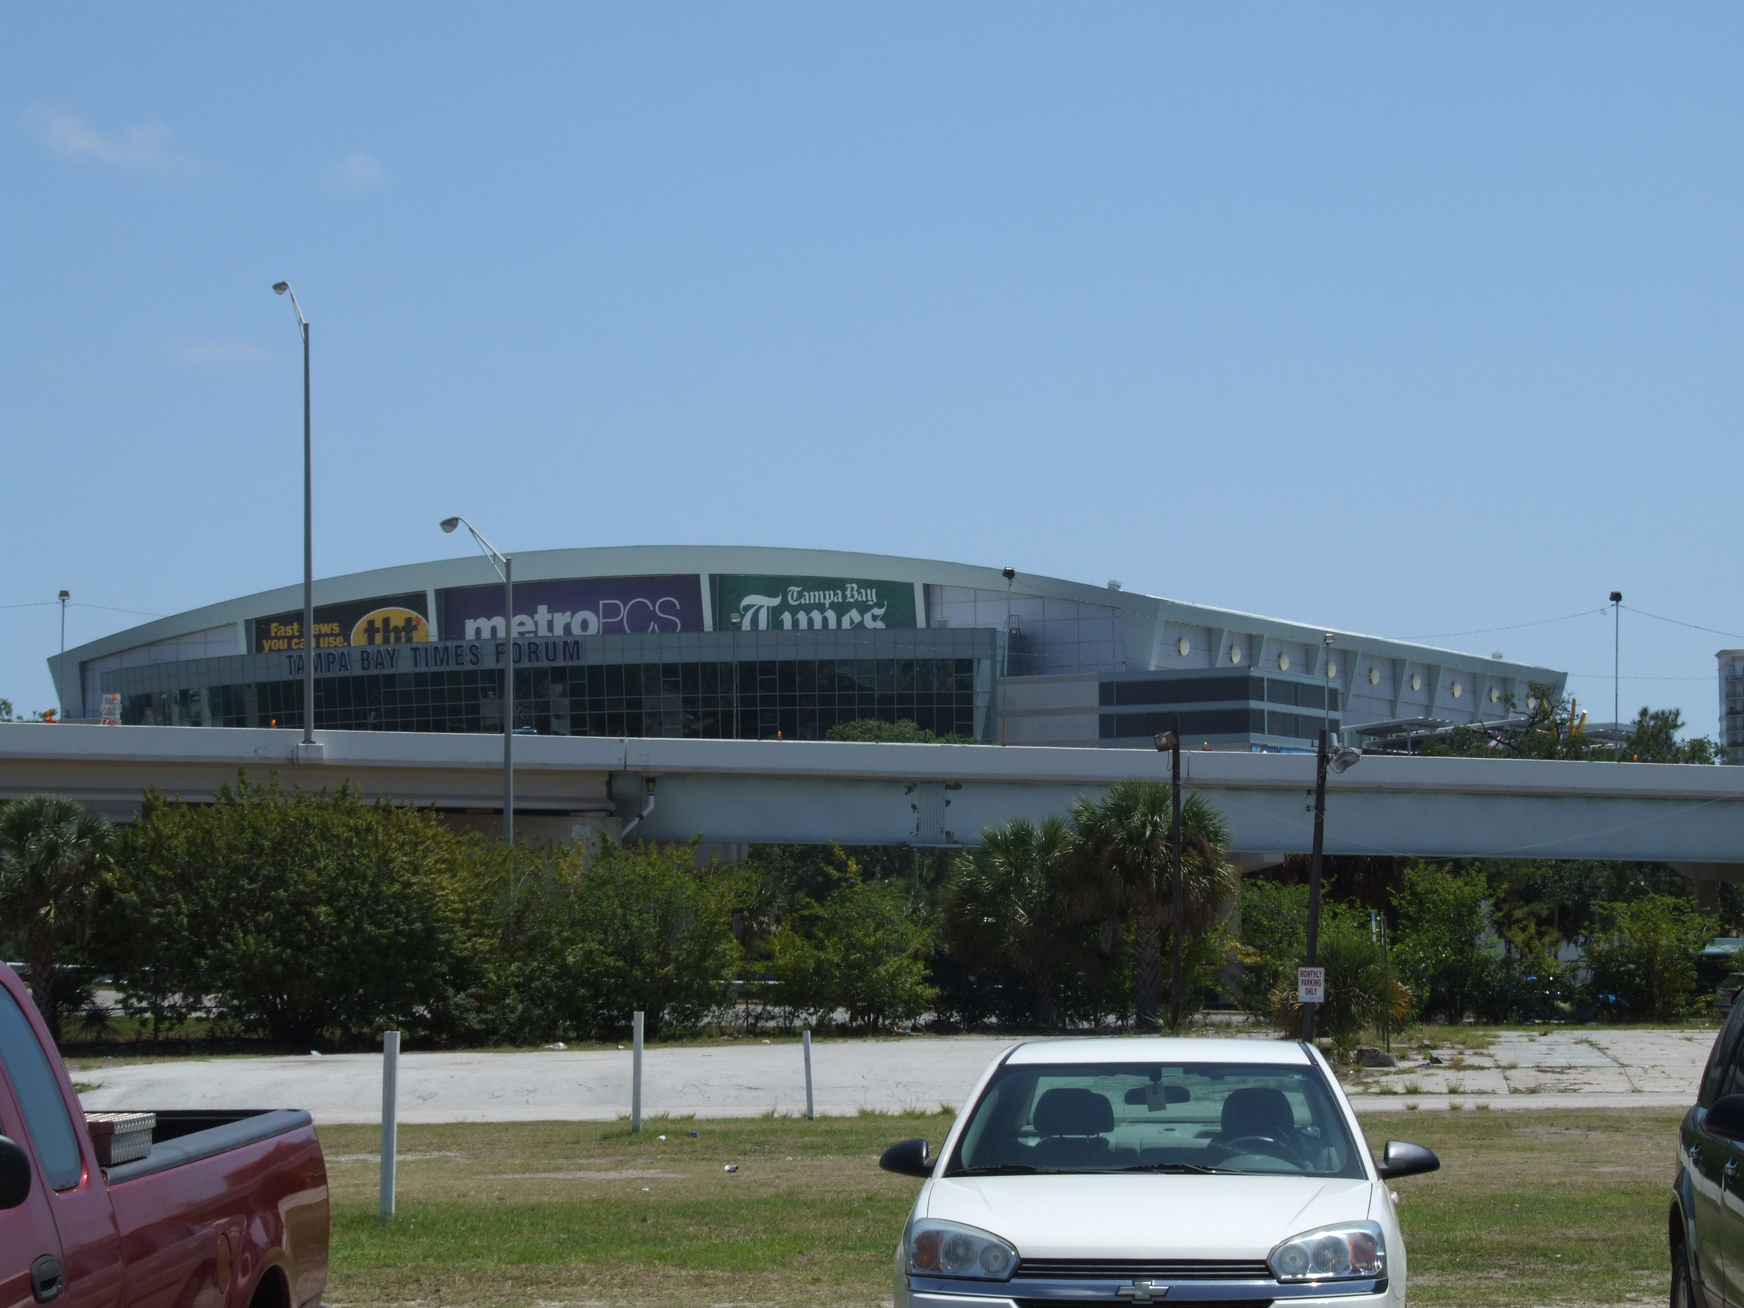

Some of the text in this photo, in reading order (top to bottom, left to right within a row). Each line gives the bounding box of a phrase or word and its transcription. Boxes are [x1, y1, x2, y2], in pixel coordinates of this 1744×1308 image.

[787, 583, 877, 609] Tampa Bay
[465, 597, 681, 640] metroPCS
[740, 594, 887, 631] Times
[270, 622, 340, 637] Fast ews
[262, 639, 288, 653] you
[320, 635, 348, 648] use.
[286, 639, 582, 675] TAMPA BAY TIMES FORUM
[1300, 970, 1322, 978] MONTHLY
[1301, 979, 1321, 987] PARKING
[1305, 987, 1317, 995] ONLY
